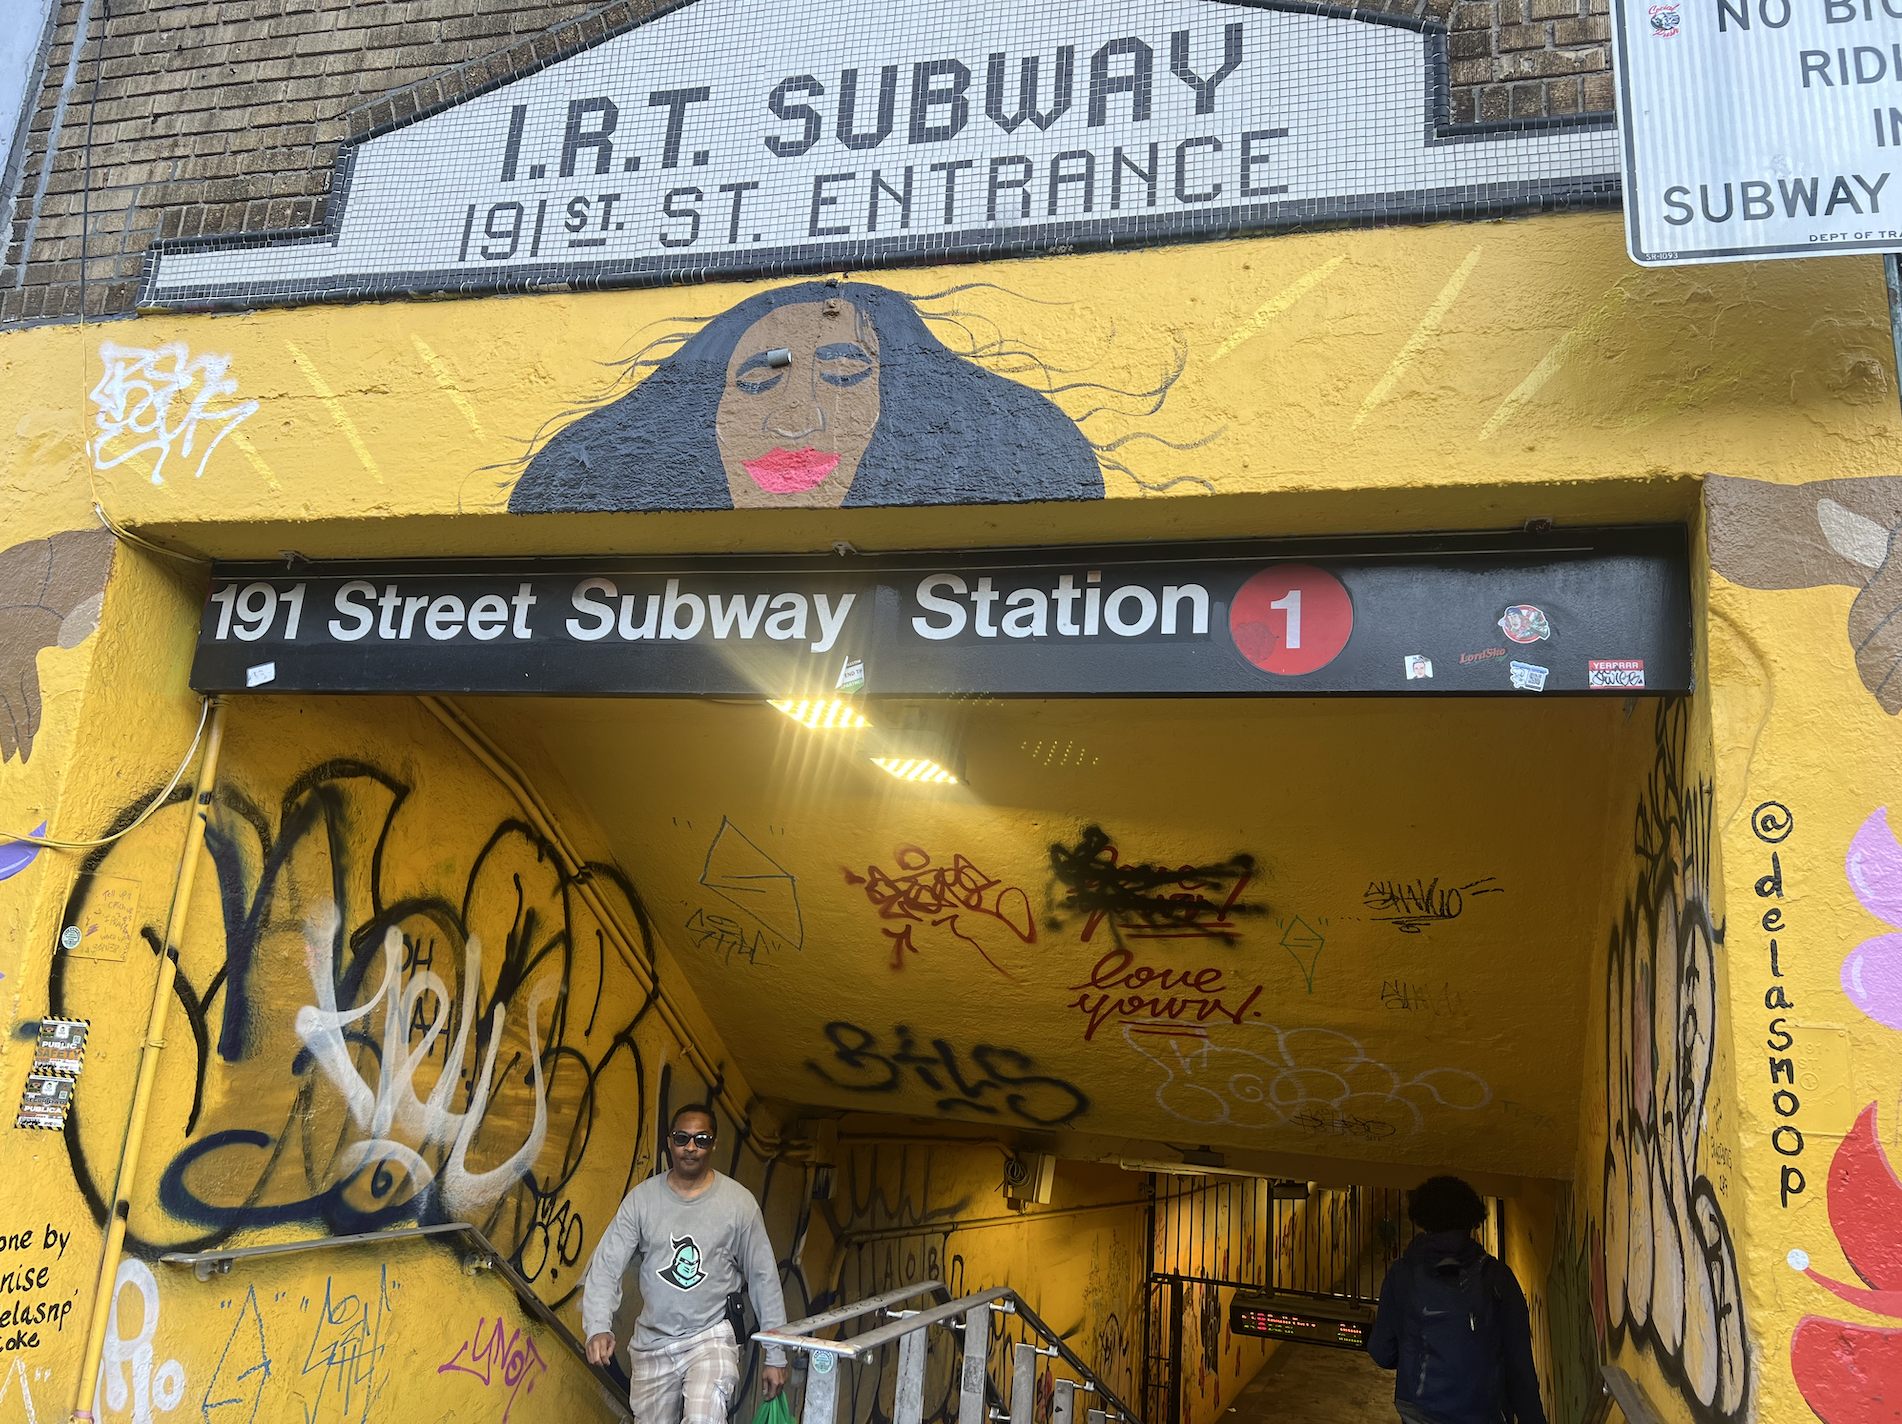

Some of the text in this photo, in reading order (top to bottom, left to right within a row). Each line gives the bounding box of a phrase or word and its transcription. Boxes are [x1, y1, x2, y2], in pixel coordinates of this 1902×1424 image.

[1718, 0, 1791, 32] NO
[500, 22, 1243, 182] I.R.T. SUBWAY
[660, 181, 761, 248] ST.
[809, 128, 1288, 236] ENTRANCE
[1663, 172, 1891, 225] SUBWAY
[1809, 230, 1902, 242] DEPT OF TR
[1645, 252, 1679, 260] SR-1093
[211, 570, 1301, 653] 191 Street Subway Station 1
[1068, 948, 1227, 993] love
[37, 1047, 81, 1060] SAFETY
[41, 1040, 78, 1049] PUBLIC
[23, 1105, 62, 1114] PUBLICA
[43, 1223, 70, 1261] by
[0, 1264, 50, 1294] nise
